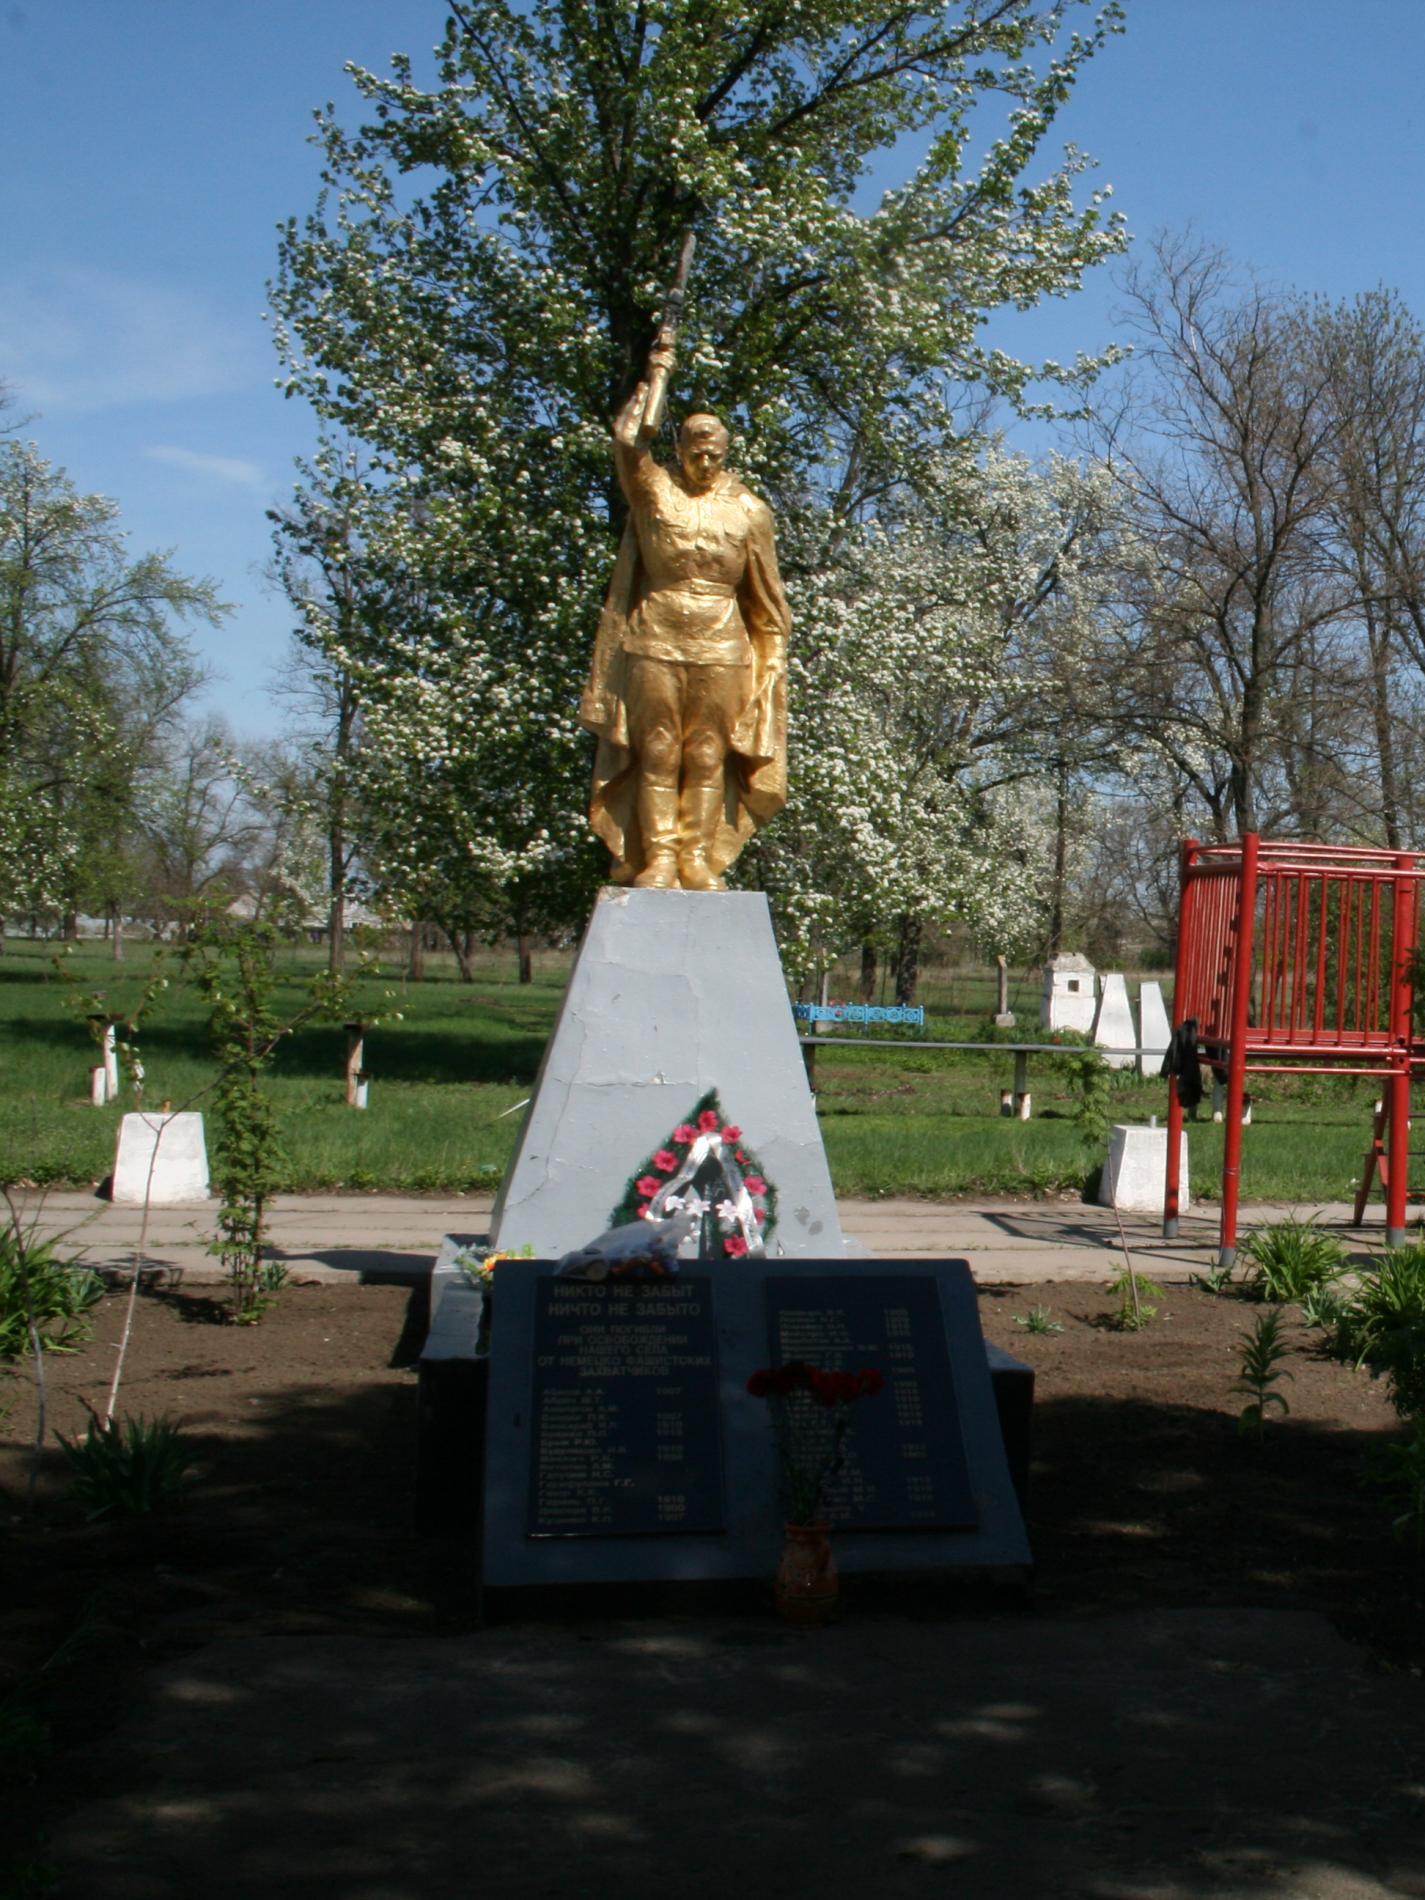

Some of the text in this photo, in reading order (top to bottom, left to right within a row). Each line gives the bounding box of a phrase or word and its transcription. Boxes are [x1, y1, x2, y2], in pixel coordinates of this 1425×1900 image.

[553, 1284, 695, 1298] НИКТО НЕ ЗАБЫТ
[547, 1302, 701, 1316] НИЧТО НЕ ЗАБЫТО
